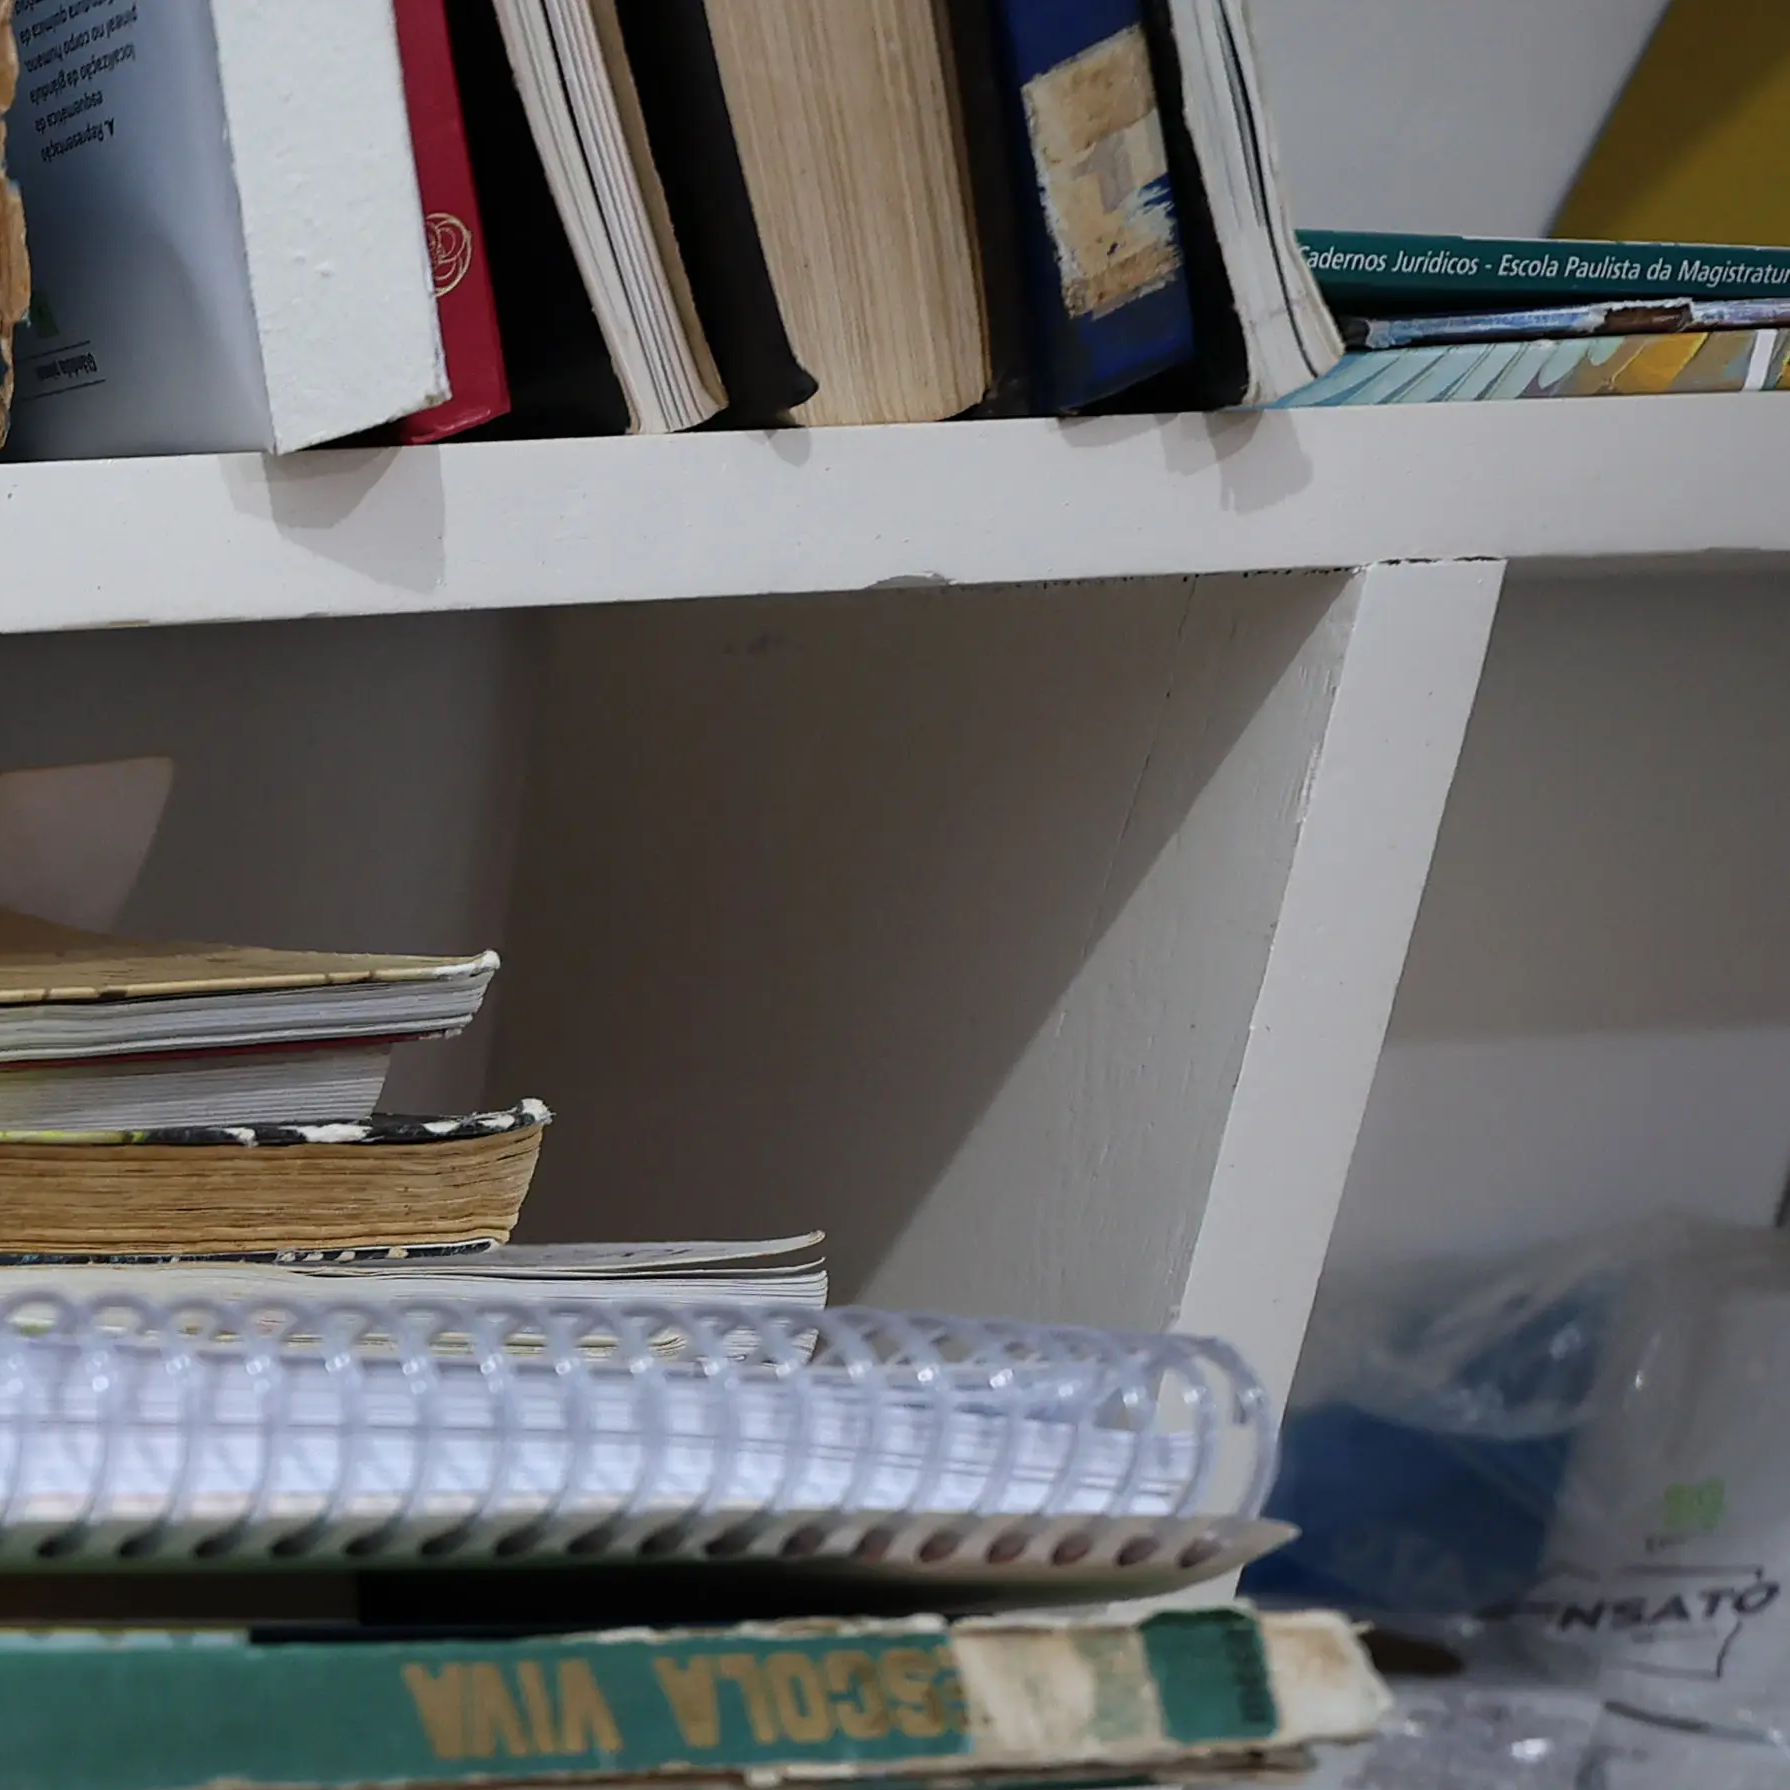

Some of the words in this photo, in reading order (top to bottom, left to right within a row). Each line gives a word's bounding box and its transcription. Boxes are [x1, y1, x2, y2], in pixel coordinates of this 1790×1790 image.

[1391, 249, 1480, 276] Jurídicos
[1497, 254, 1559, 279] Escola
[1564, 258, 1641, 282] Paulista
[1646, 259, 1672, 282] da
[401, 1656, 625, 1761] VIVA
